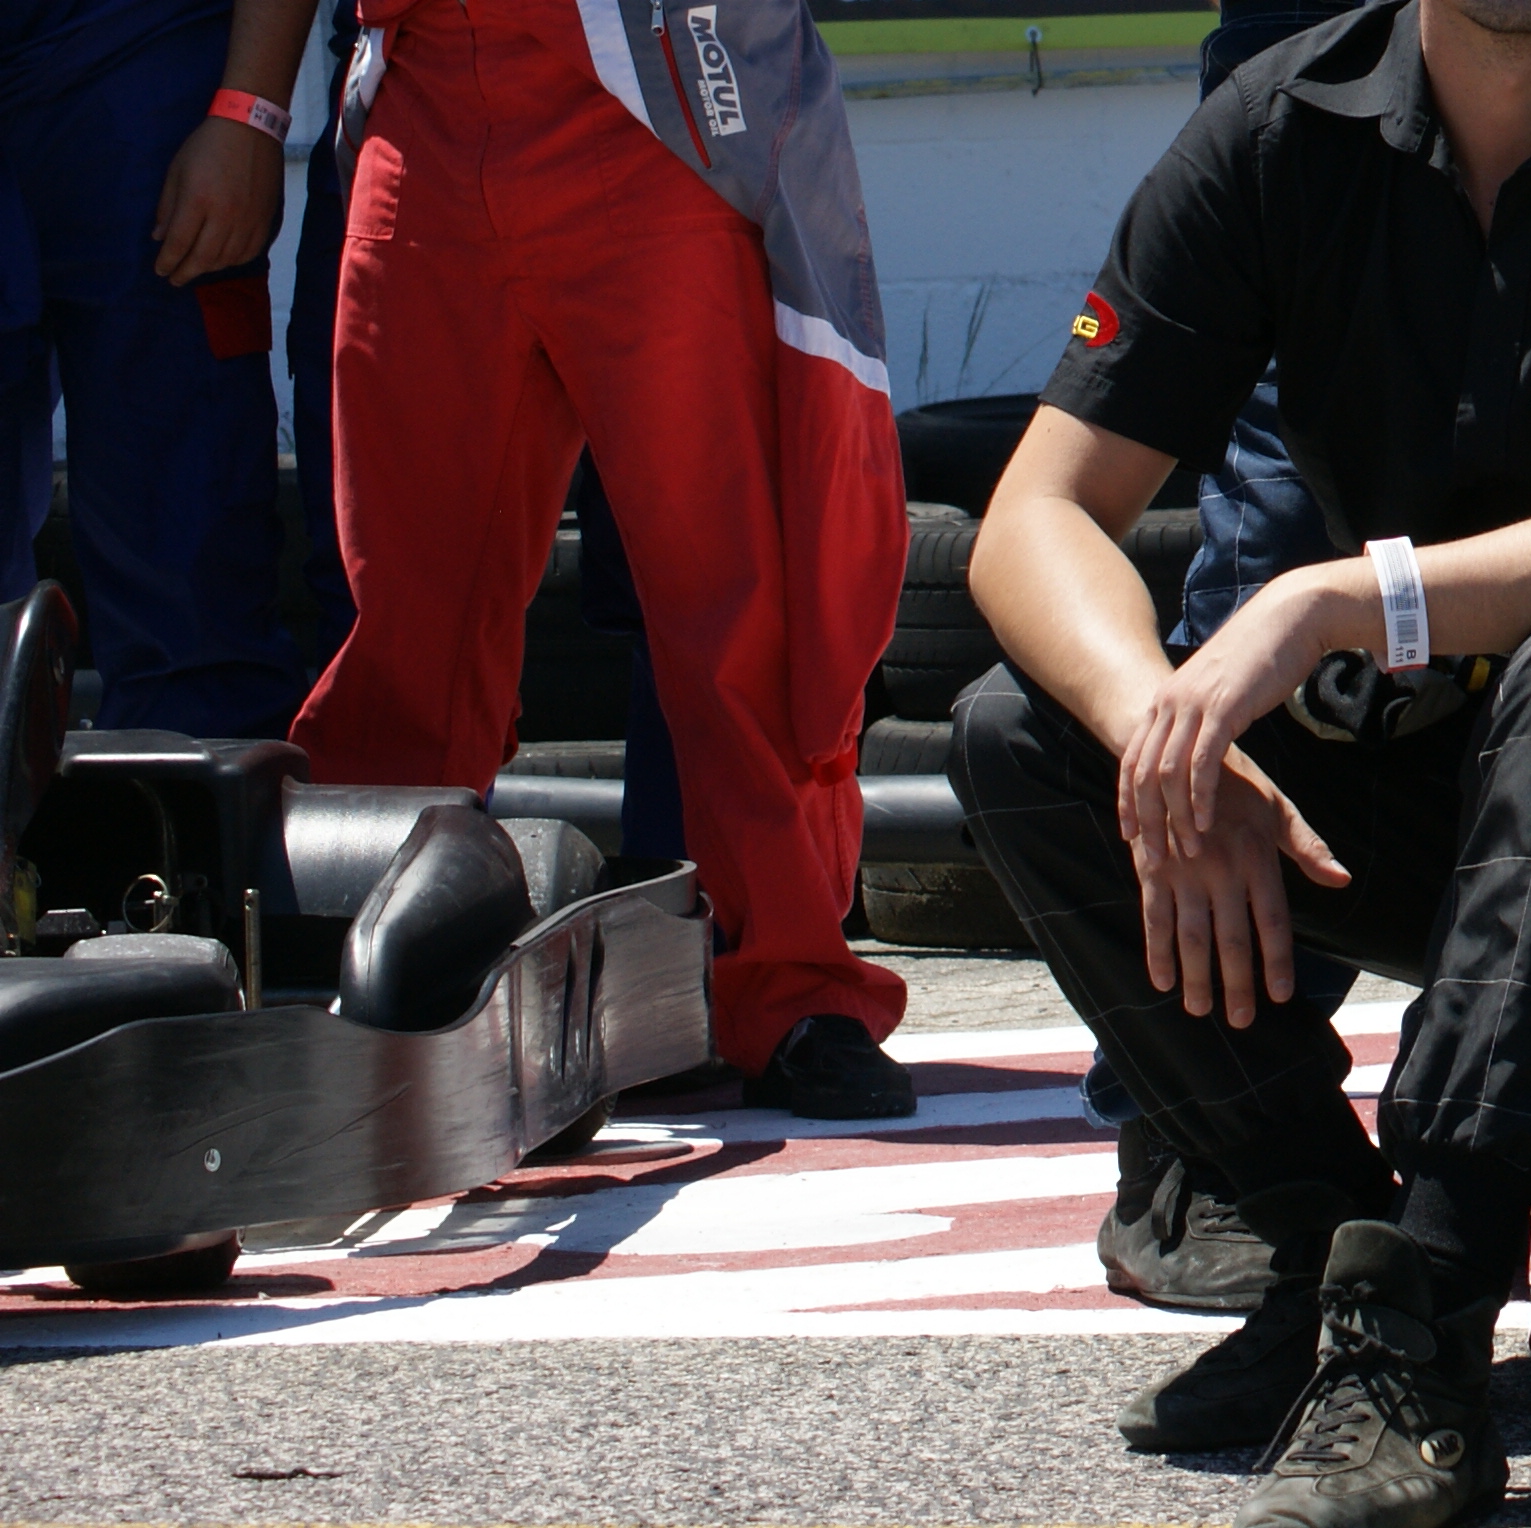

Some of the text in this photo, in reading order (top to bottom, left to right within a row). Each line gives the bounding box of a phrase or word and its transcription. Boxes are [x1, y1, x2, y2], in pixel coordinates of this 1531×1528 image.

[691, 15, 740, 126] MOTUL
[697, 79, 719, 136] MOTOR OIL
